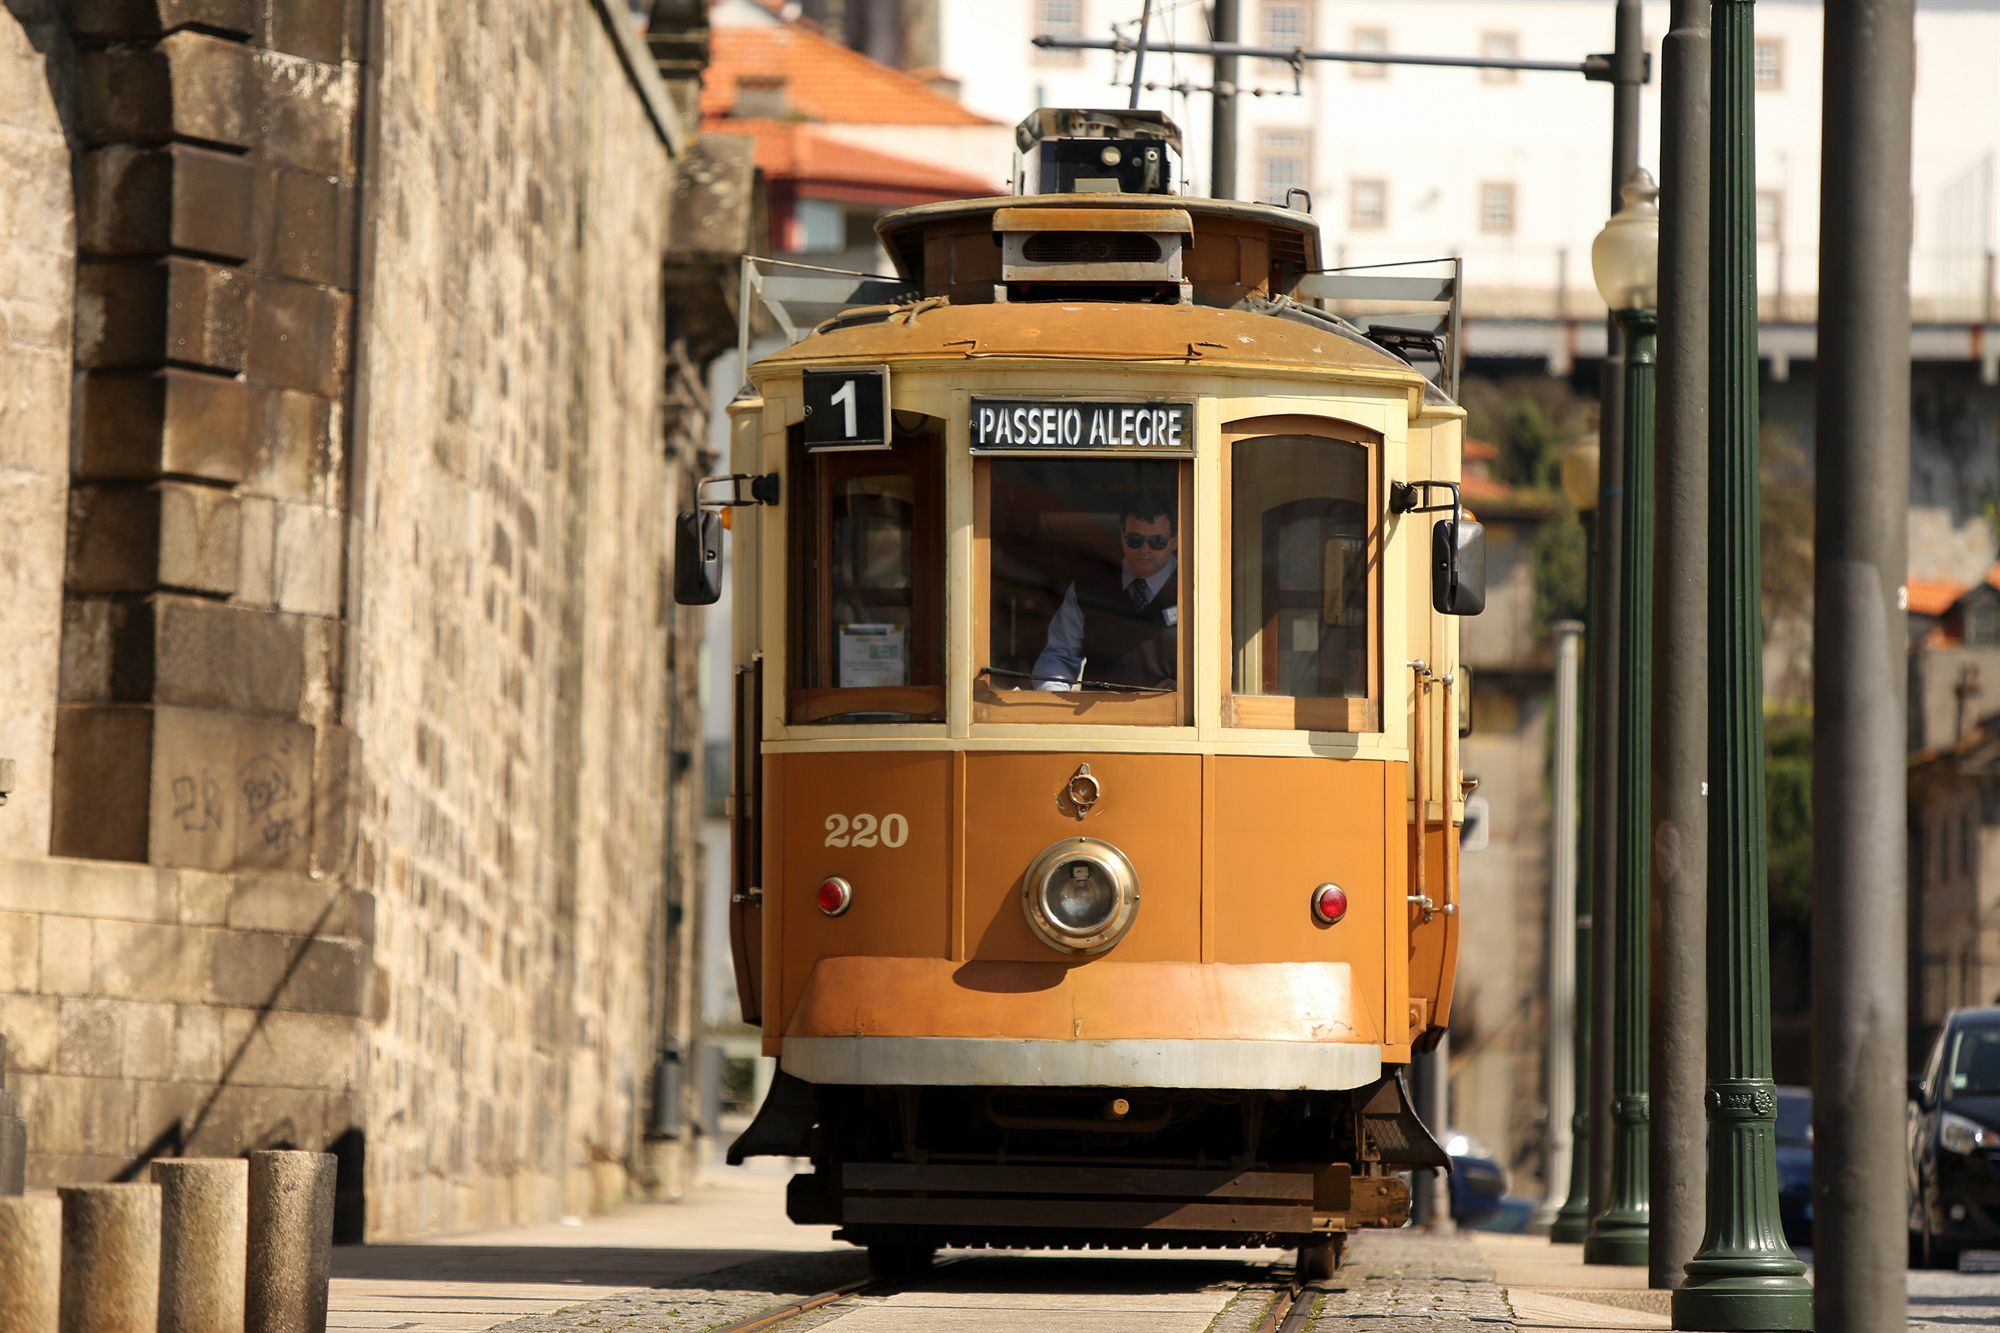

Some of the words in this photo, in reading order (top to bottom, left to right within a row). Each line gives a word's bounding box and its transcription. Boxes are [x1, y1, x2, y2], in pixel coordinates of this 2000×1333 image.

[831, 380, 857, 438] 1
[979, 407, 1082, 446] PASSEIO
[1089, 408, 1182, 447] ALEGRE
[824, 813, 909, 848] 220
